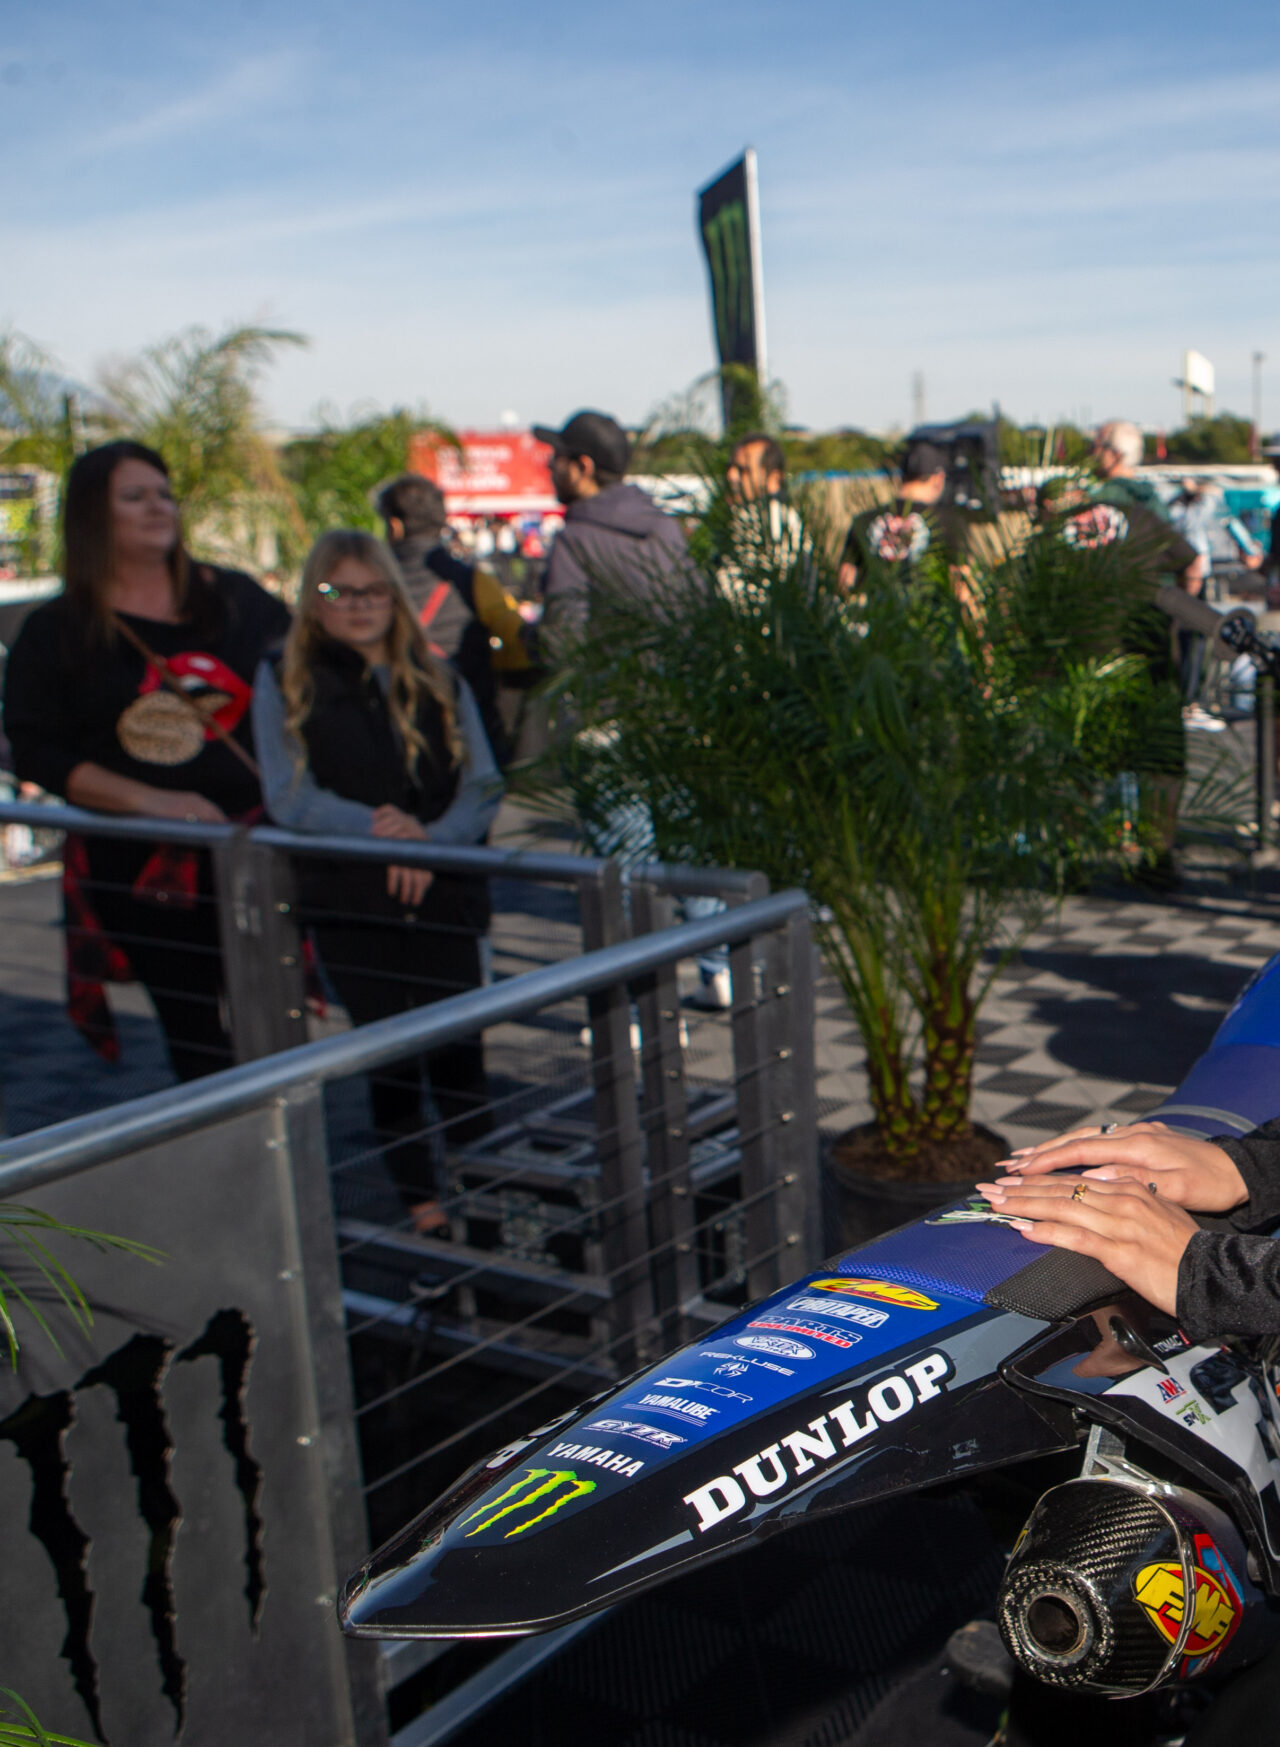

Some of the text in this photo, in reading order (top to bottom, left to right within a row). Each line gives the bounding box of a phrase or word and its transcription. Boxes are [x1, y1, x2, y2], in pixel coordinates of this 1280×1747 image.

[790, 1299, 885, 1327] PROTAPER
[747, 1321, 853, 1349] UNLIMITED
[757, 1315, 863, 1344] PARTS
[699, 1351, 797, 1377] REKLUSE
[1156, 1376, 1186, 1402] AMA
[638, 1394, 718, 1420] YAMALUBE
[586, 1419, 684, 1447] GYTR
[682, 1353, 949, 1533] DUNLOP
[546, 1442, 646, 1478] YAMAHA
